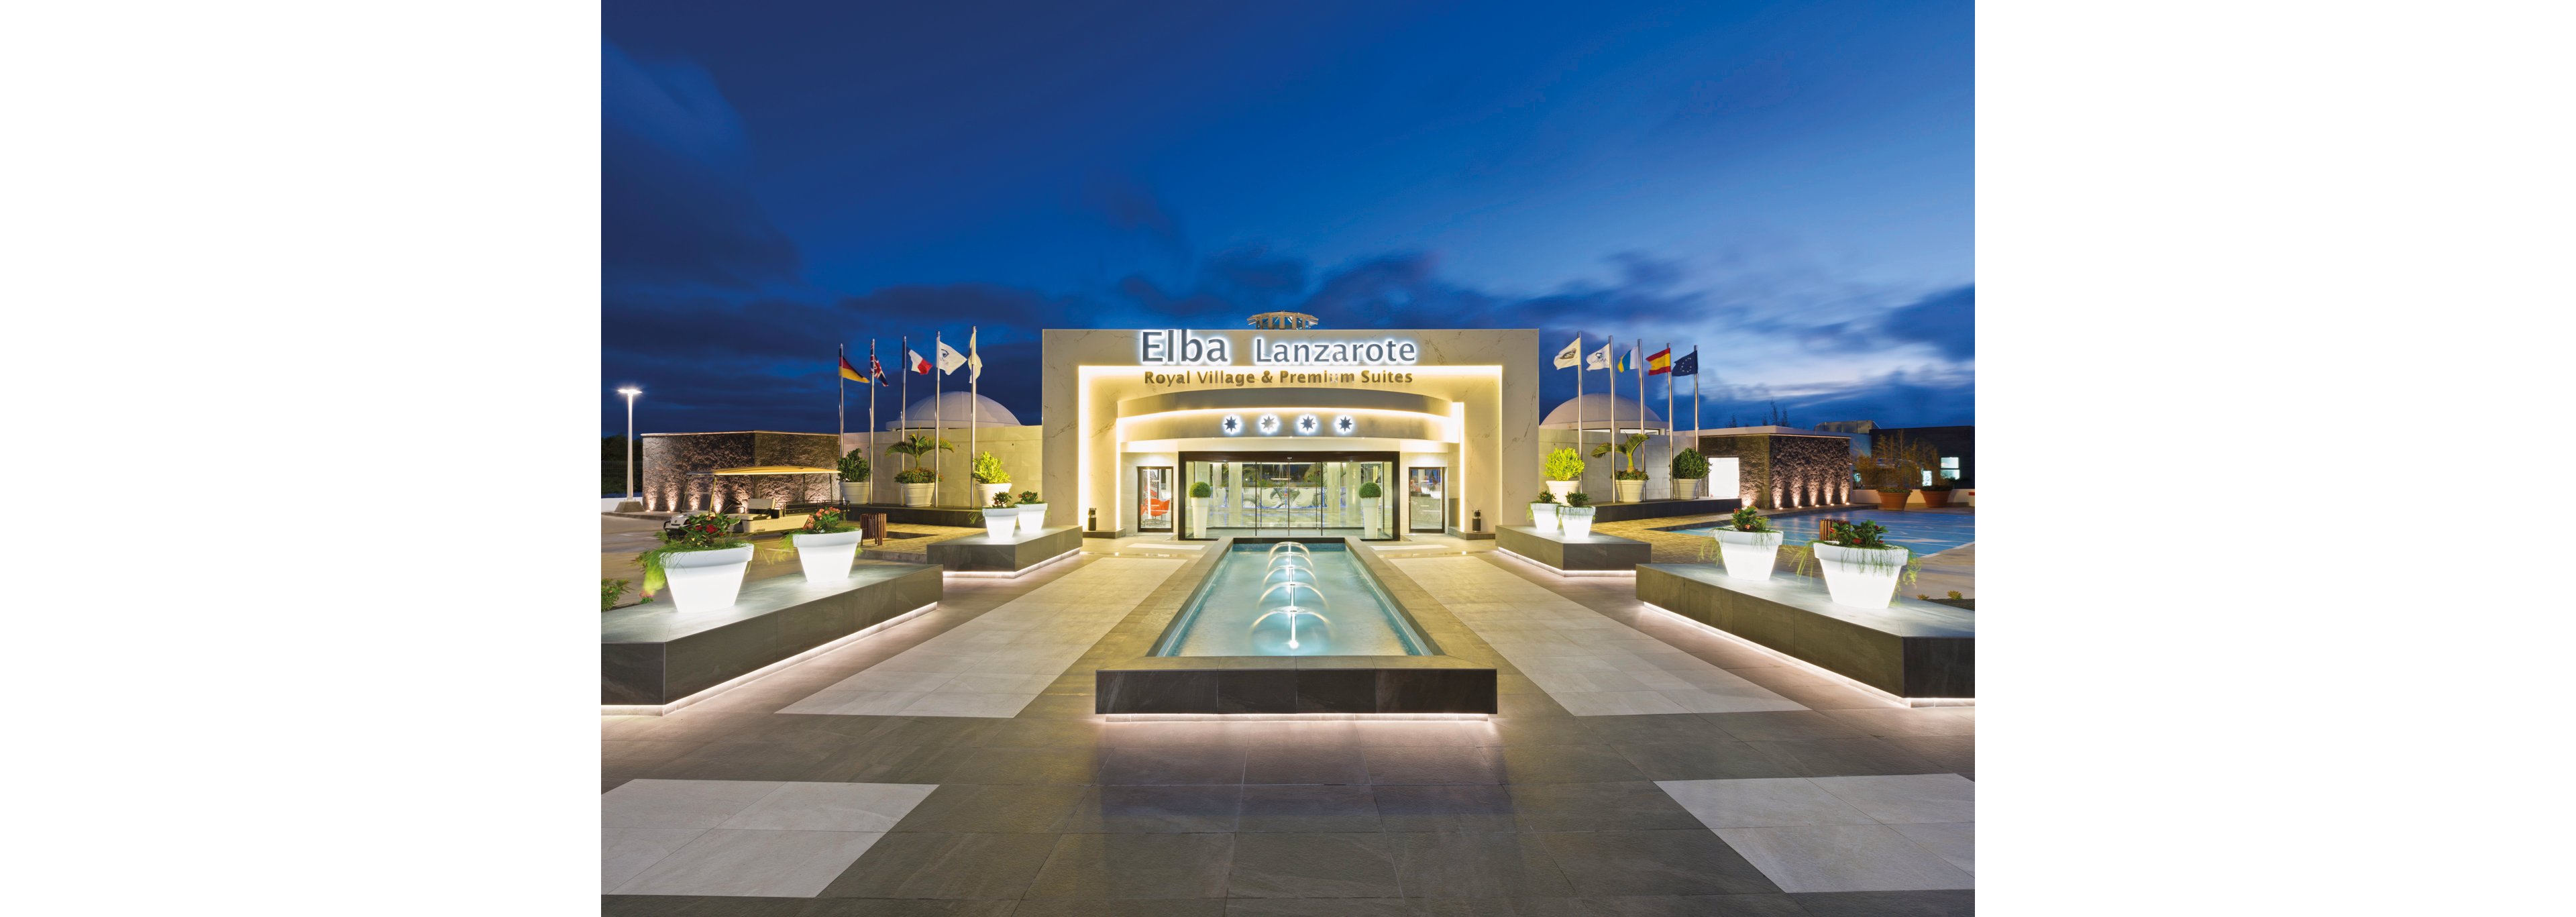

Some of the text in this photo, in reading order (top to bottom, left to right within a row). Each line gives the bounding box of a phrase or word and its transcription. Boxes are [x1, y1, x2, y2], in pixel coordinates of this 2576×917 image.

[1142, 329, 1415, 362] Elba Lanzarote
[1144, 370, 1413, 387] Royal Village & Premium Suites
